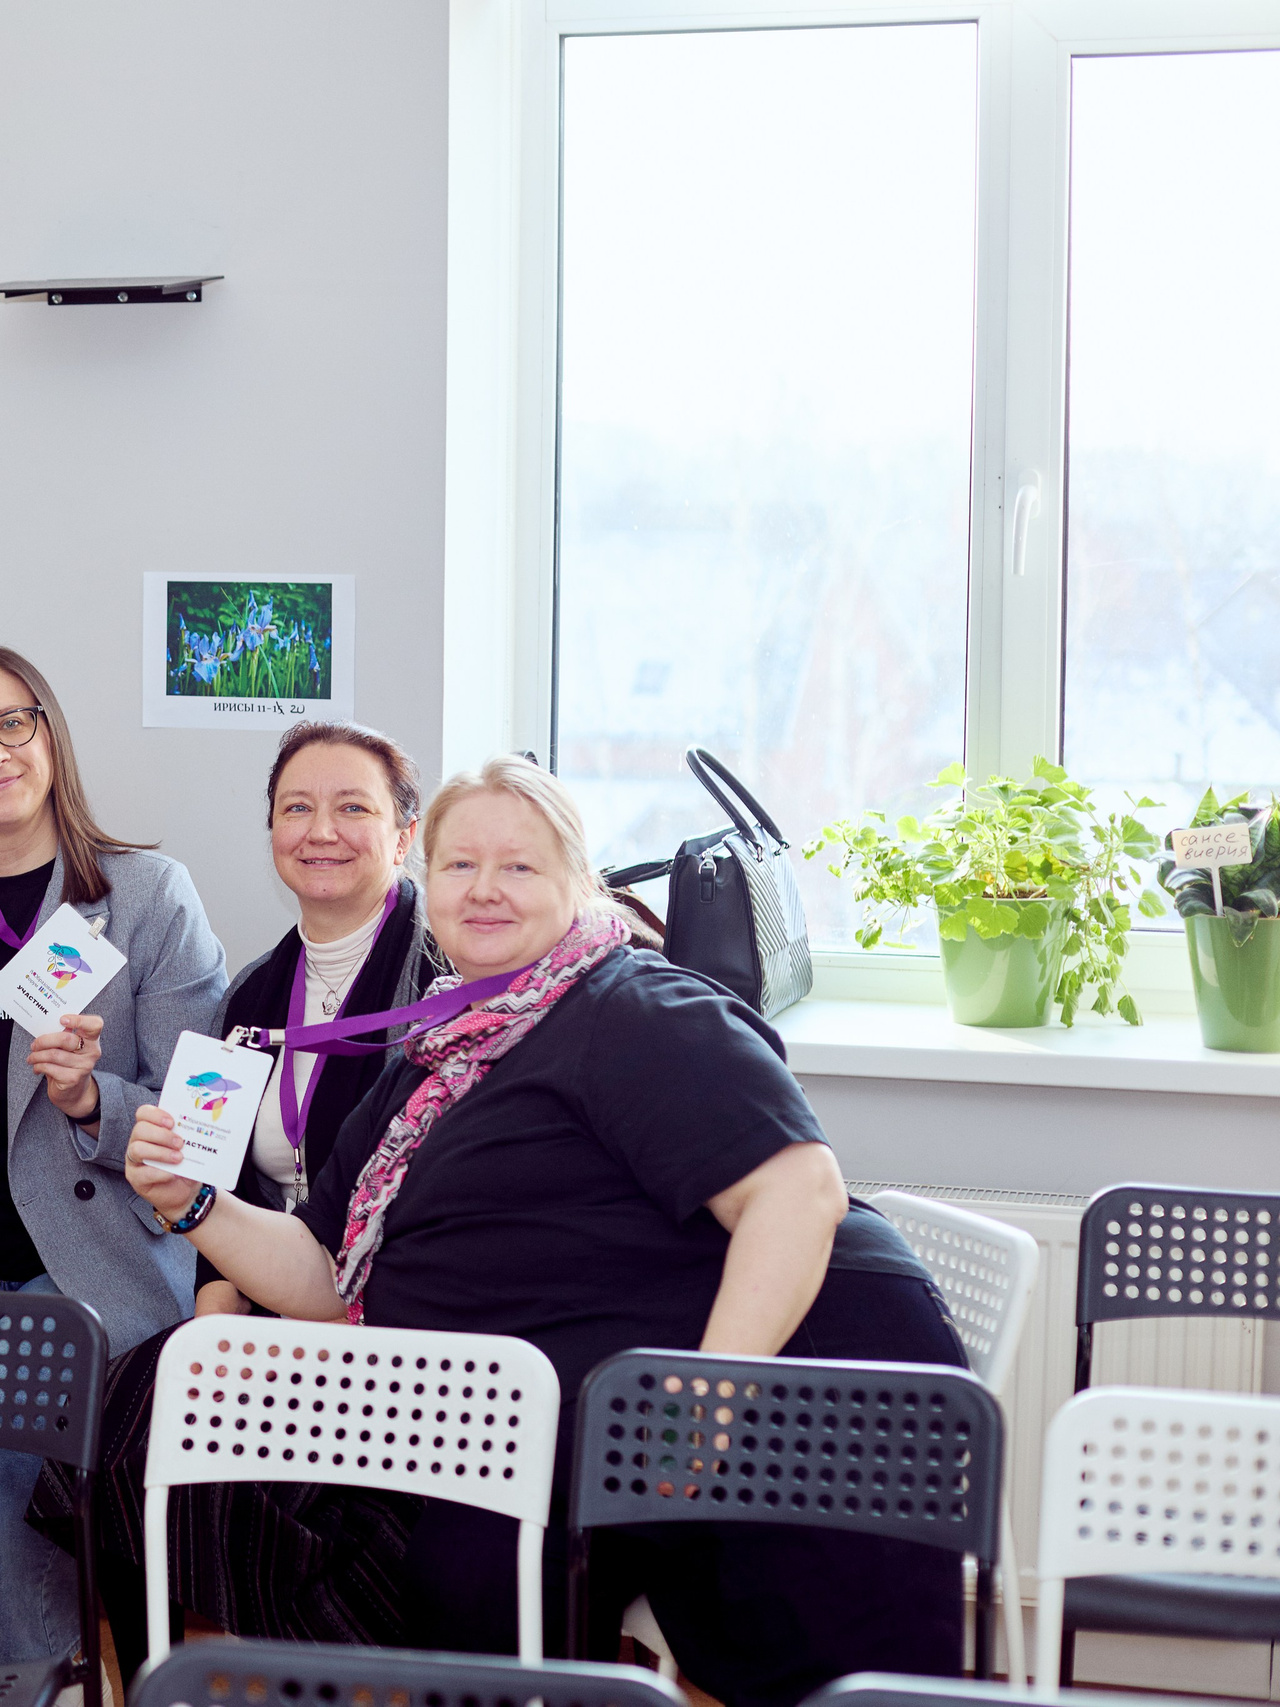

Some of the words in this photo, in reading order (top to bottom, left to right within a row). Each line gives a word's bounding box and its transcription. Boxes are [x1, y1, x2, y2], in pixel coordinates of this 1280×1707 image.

[213, 702, 254, 713] ИРИСЫ
[1185, 845, 1248, 860] виерия
[16, 985, 49, 1015] УЧАСТНИК
